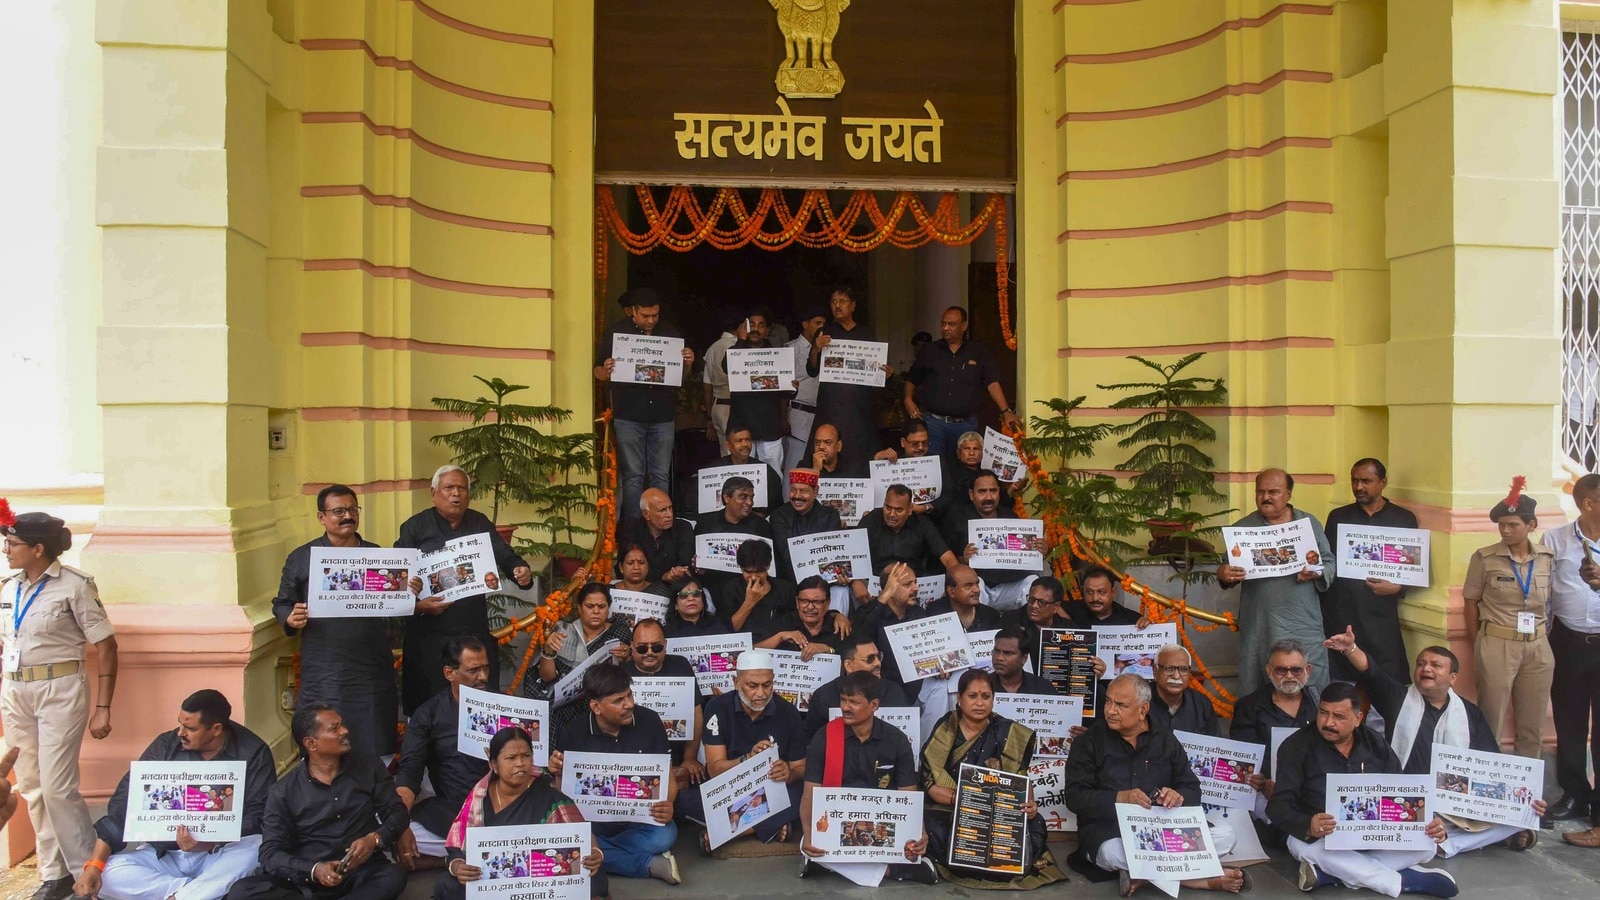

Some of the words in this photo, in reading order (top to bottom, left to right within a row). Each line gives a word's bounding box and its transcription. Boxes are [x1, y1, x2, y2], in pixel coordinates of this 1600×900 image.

[674, 96, 826, 161] सत्यमेव
[842, 99, 944, 163] जयते
[631, 347, 663, 356] मताधिकार
[1275, 535, 1301, 547] अधिकार
[810, 545, 844, 555] मताधिकार
[417, 567, 427, 576] वोट
[453, 553, 480, 564] अधिकार
[706, 713, 719, 736] 4
[602, 764, 632, 772] पुनरीक्षण
[170, 772, 202, 783] पुनरीक्षण
[707, 784, 726, 798] मतदाता
[728, 771, 750, 788] पुनरीक्षण
[752, 761, 766, 771] बहाना
[712, 795, 732, 810] मकसद
[755, 774, 768, 785] लाना
[1364, 784, 1395, 794] पुनरीक्षण
[830, 810, 844, 818] वोट
[875, 811, 907, 822] अधिकार
[511, 837, 547, 849] पुनरीक्षण
